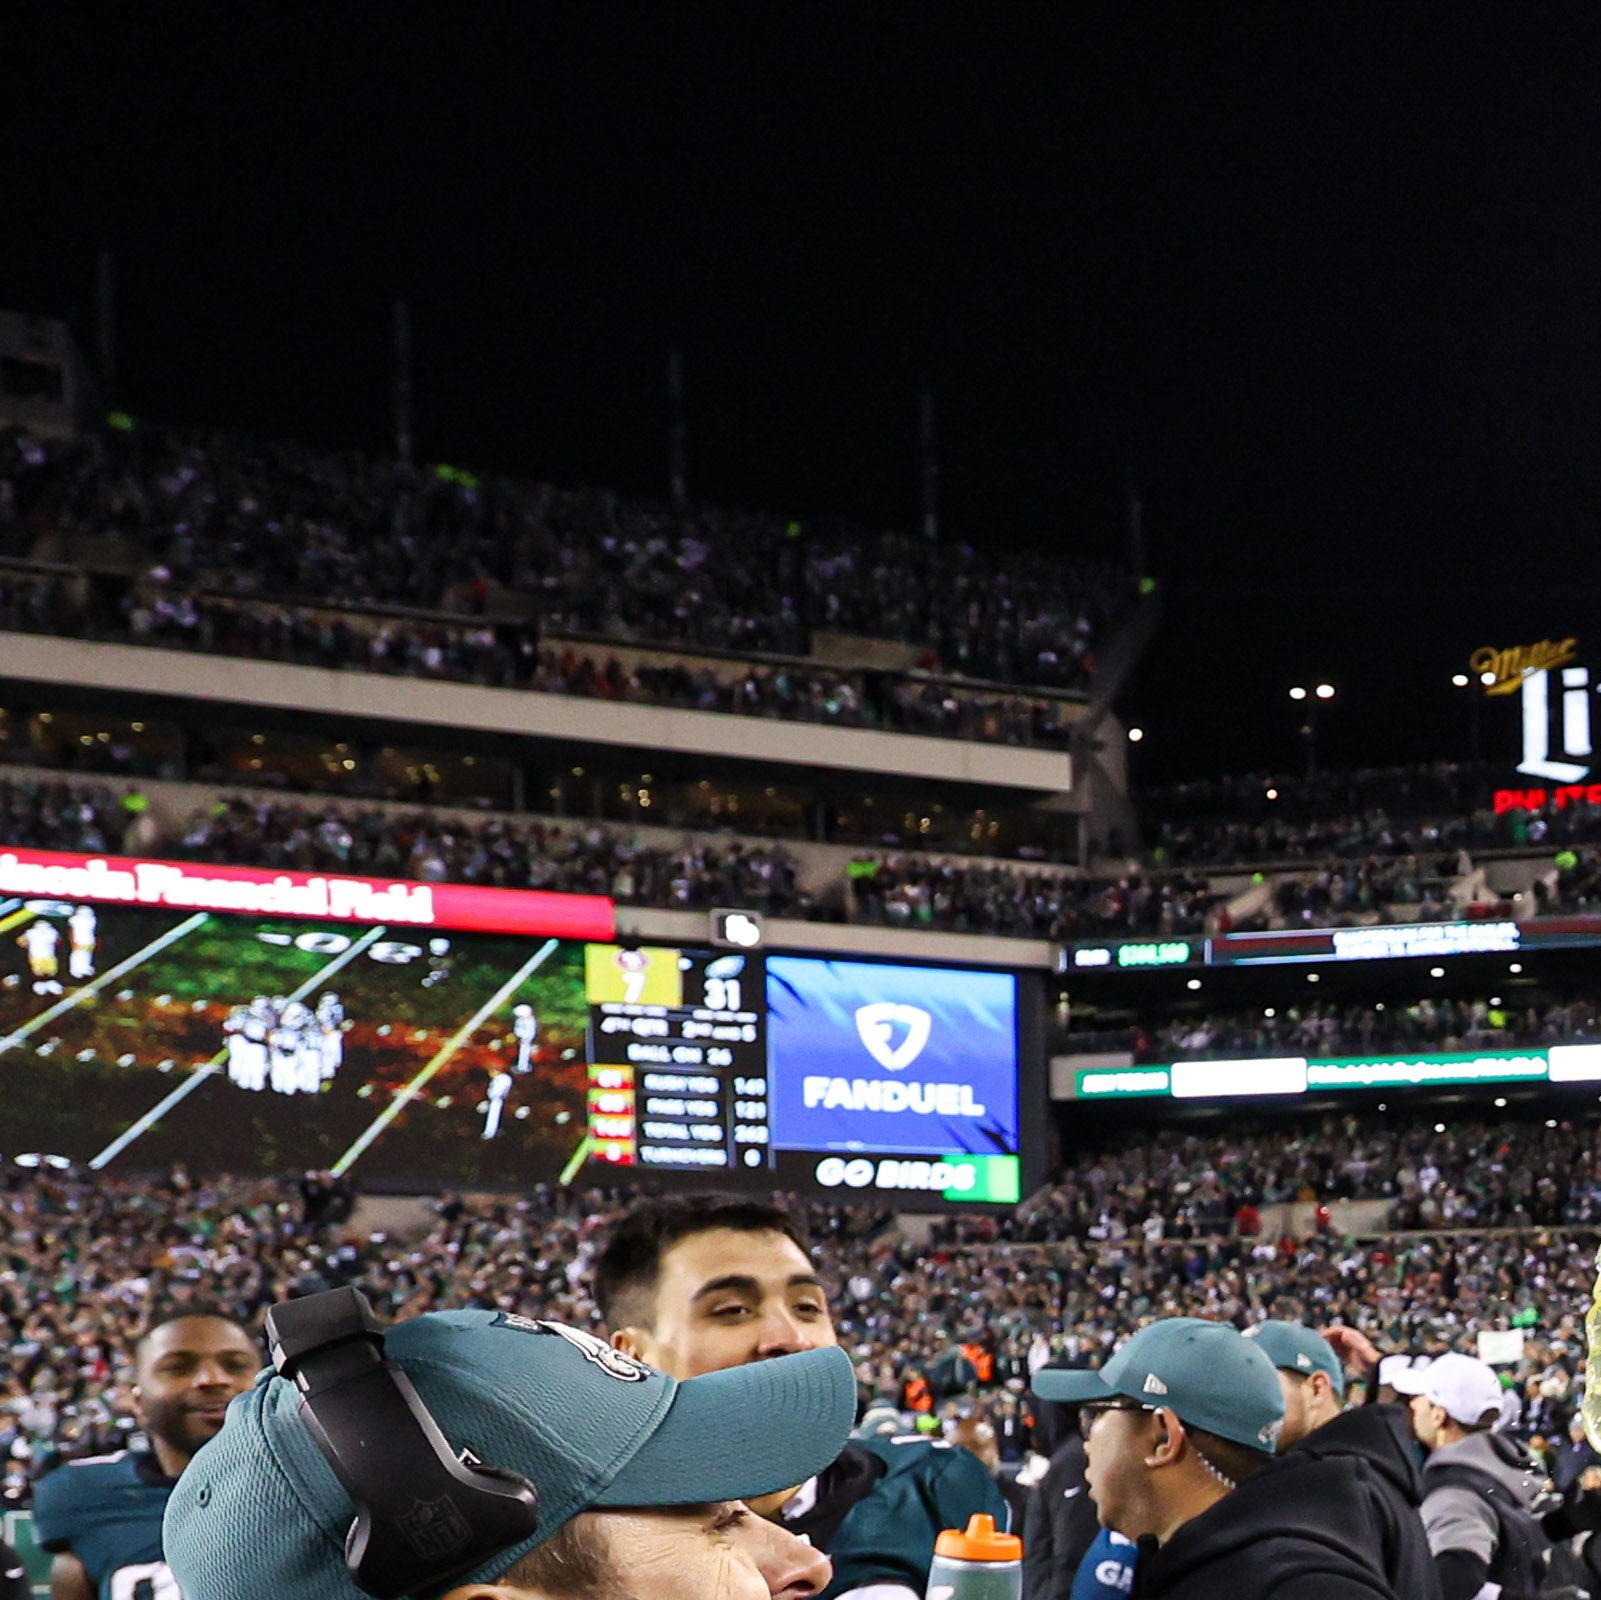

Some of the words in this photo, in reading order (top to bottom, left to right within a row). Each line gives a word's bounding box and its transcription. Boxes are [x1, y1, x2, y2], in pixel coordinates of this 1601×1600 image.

[327, 879, 436, 924] Field
[622, 971, 646, 1003] 7
[704, 978, 741, 1011] 31
[803, 1076, 985, 1116] FANDUEL
[816, 1157, 874, 1187] GO
[875, 1160, 976, 1191] BIRDS
